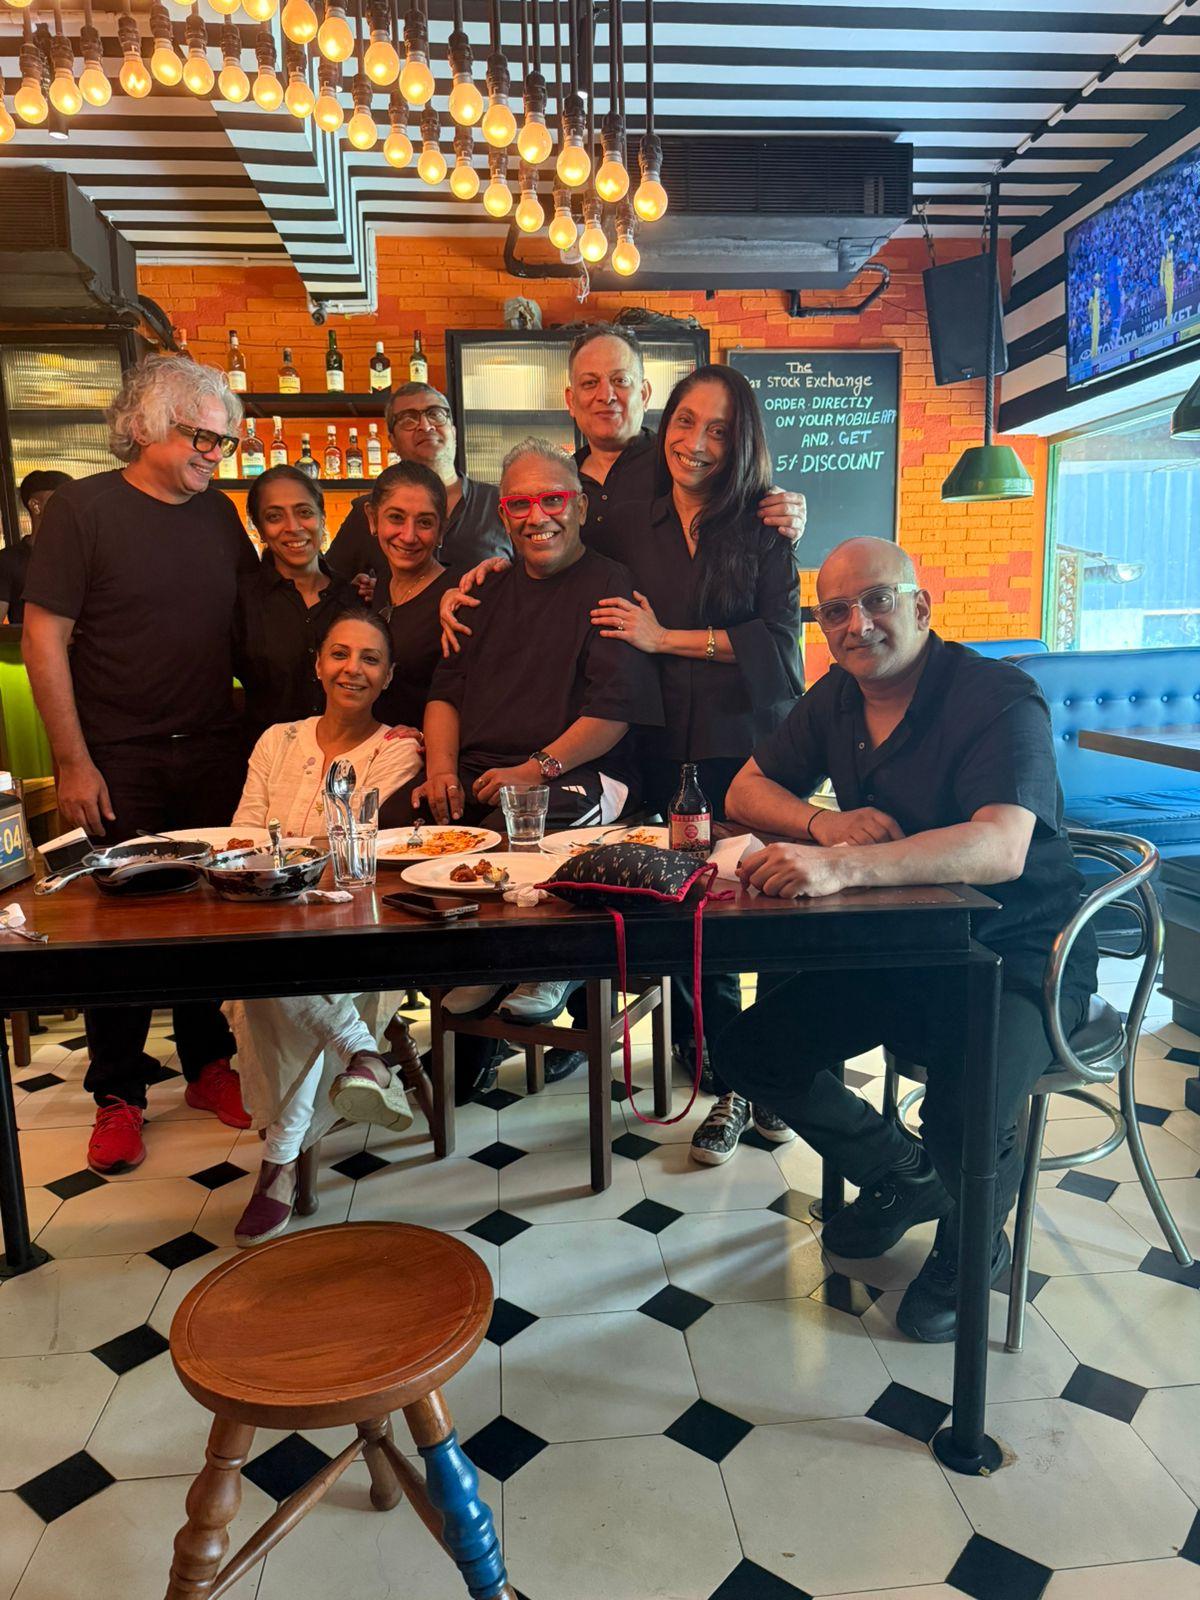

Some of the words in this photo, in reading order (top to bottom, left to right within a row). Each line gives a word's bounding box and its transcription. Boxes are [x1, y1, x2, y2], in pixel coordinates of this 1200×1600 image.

[785, 361, 813, 374] The
[767, 376, 801, 388] STOCK
[805, 371, 873, 396] Exchange
[764, 397, 806, 411] ORDER
[811, 396, 873, 410] DIRECTLY
[775, 415, 795, 428] ON
[799, 414, 833, 428] YOUR
[834, 411, 881, 426] MOBILE
[880, 409, 897, 425] APP
[838, 430, 872, 445] GET
[775, 454, 798, 472] 5%
[800, 451, 885, 473] DISCOUNT
[3, 824, 22, 855] 04
